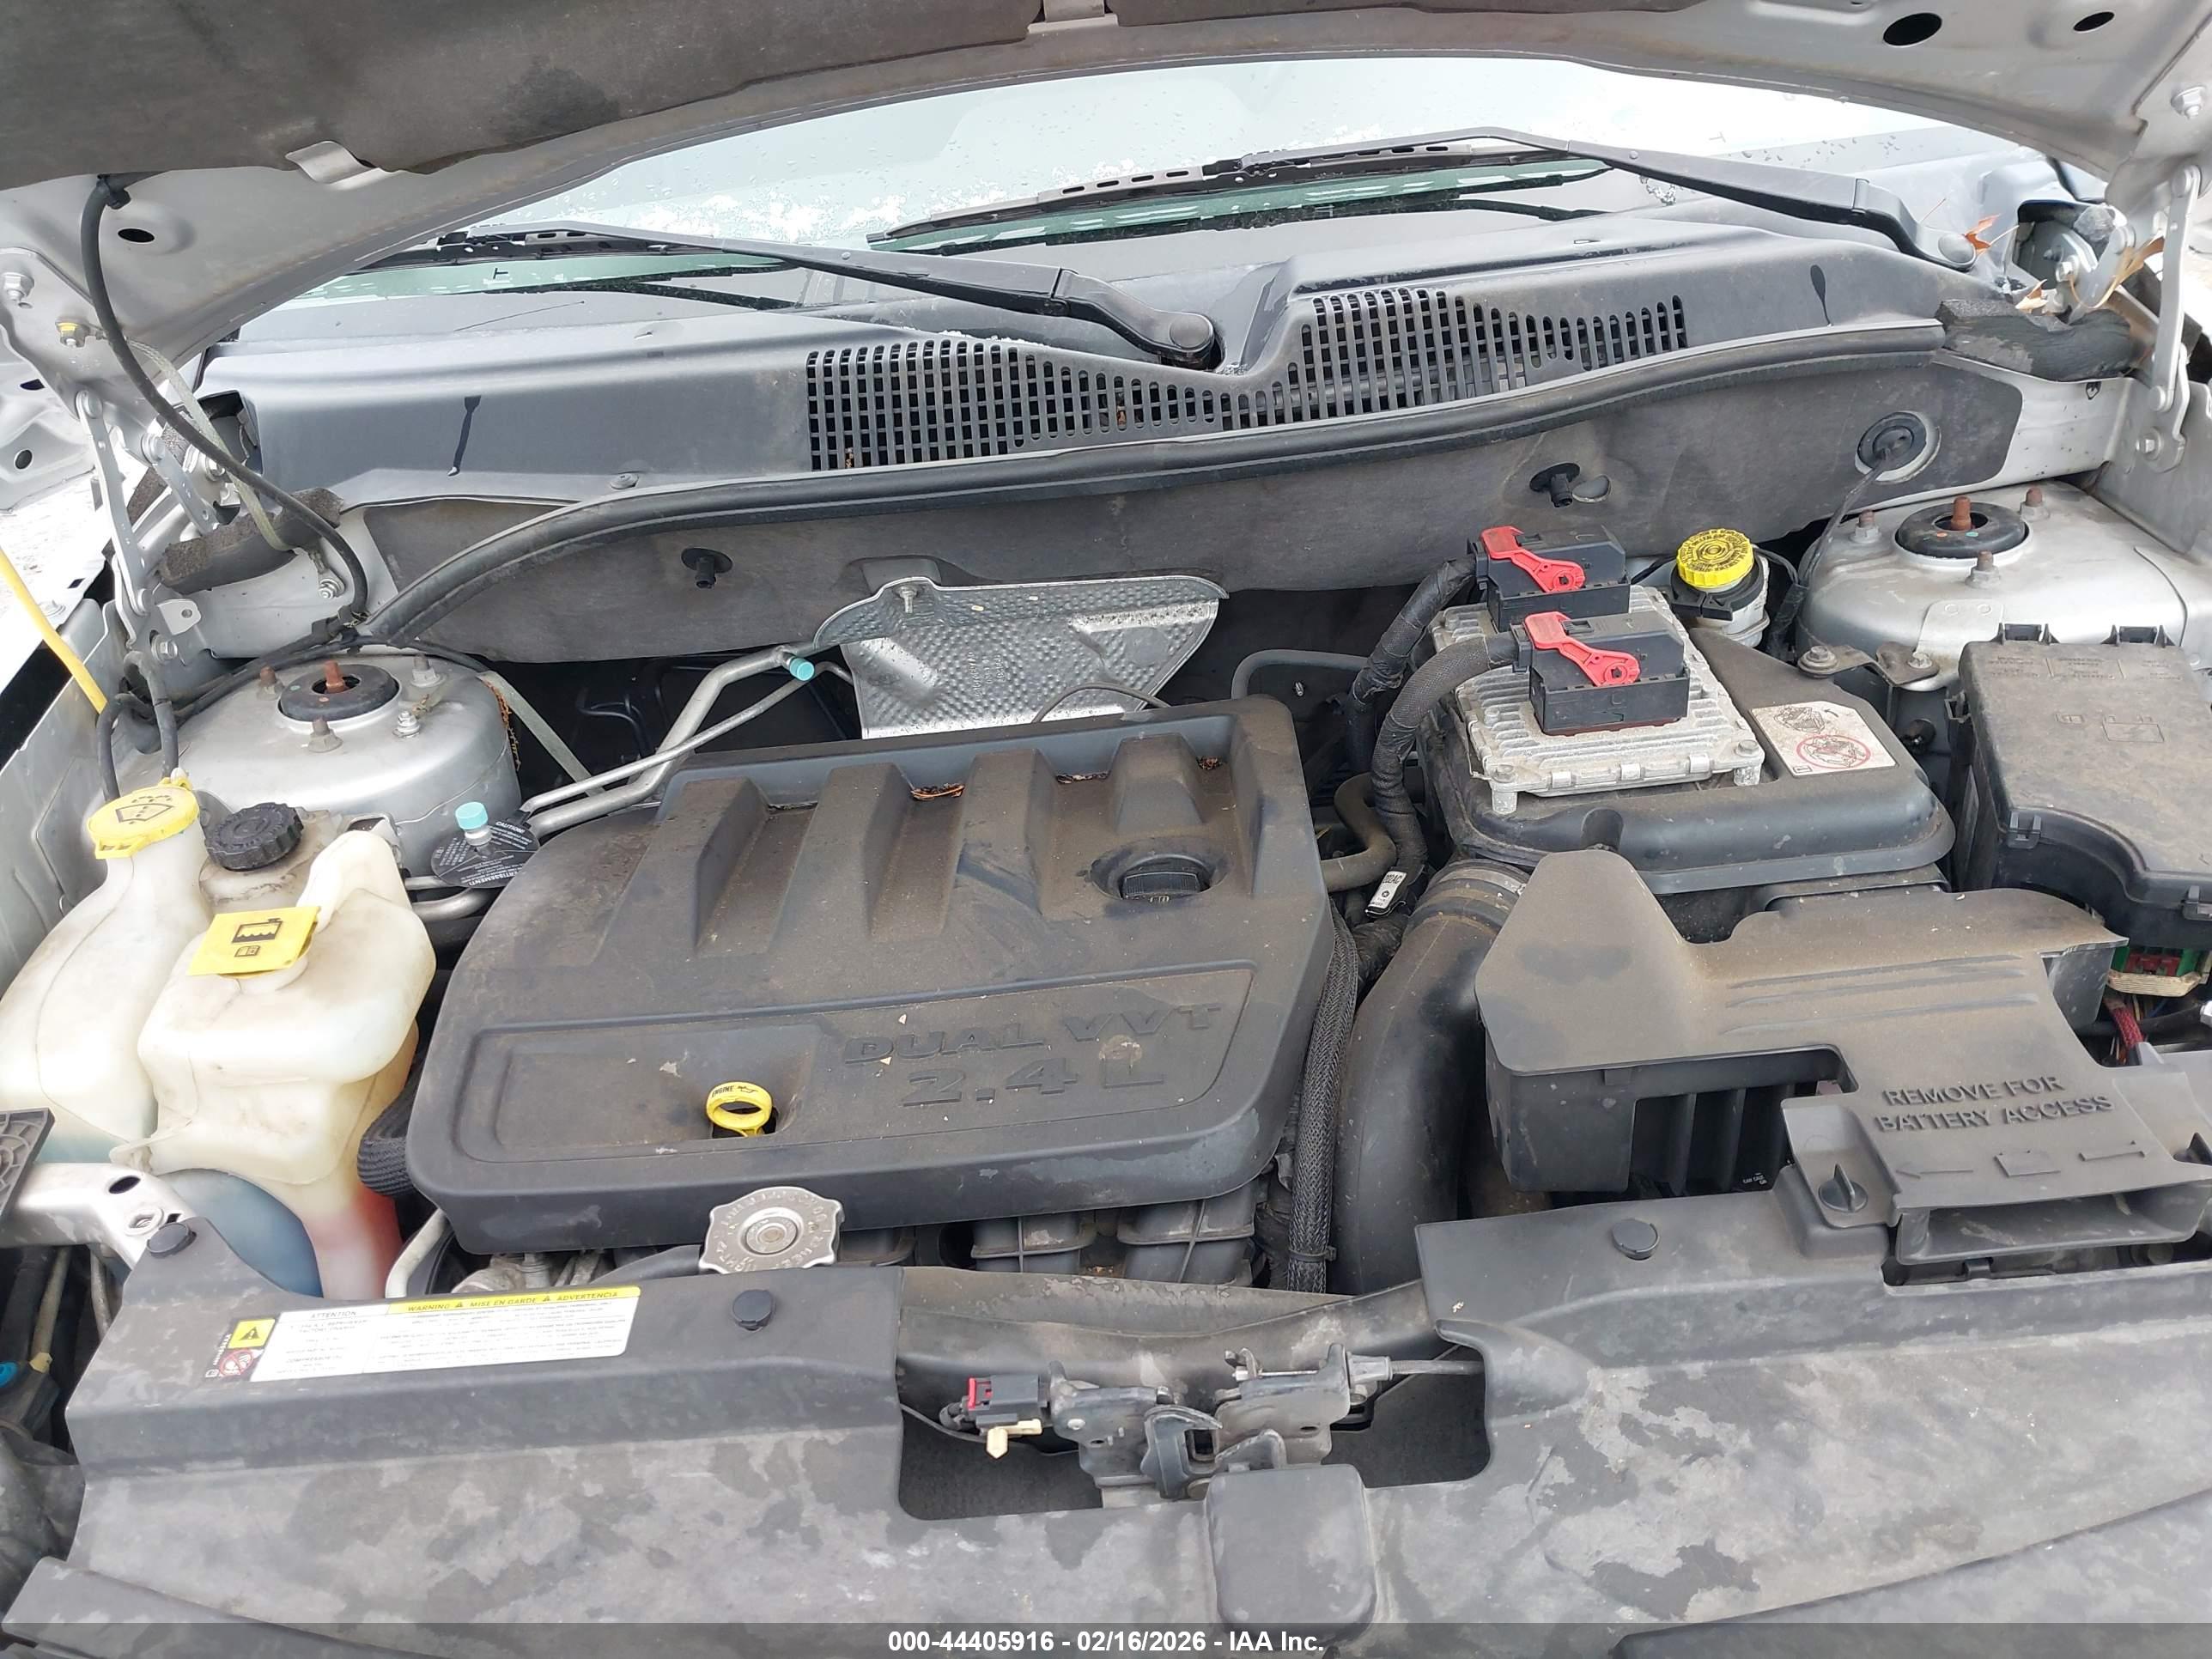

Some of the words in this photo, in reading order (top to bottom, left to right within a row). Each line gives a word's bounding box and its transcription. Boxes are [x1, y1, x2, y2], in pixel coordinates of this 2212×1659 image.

[844, 1022, 1045, 1065] DUAL
[1064, 1002, 1222, 1042] VVT
[711, 1085, 735, 1098] ENGINE
[1881, 1083, 2002, 1106] REMOVE
[2004, 1076, 2065, 1097] FOR
[1875, 1108, 1990, 1133] BATTERY
[2002, 1096, 2115, 1125] ACCESS
[408, 1303, 451, 1312] WARNING
[507, 1297, 538, 1305] GARDE
[556, 1291, 618, 1302] ADVERTENCIA
[309, 1310, 357, 1319] ATTENTION
